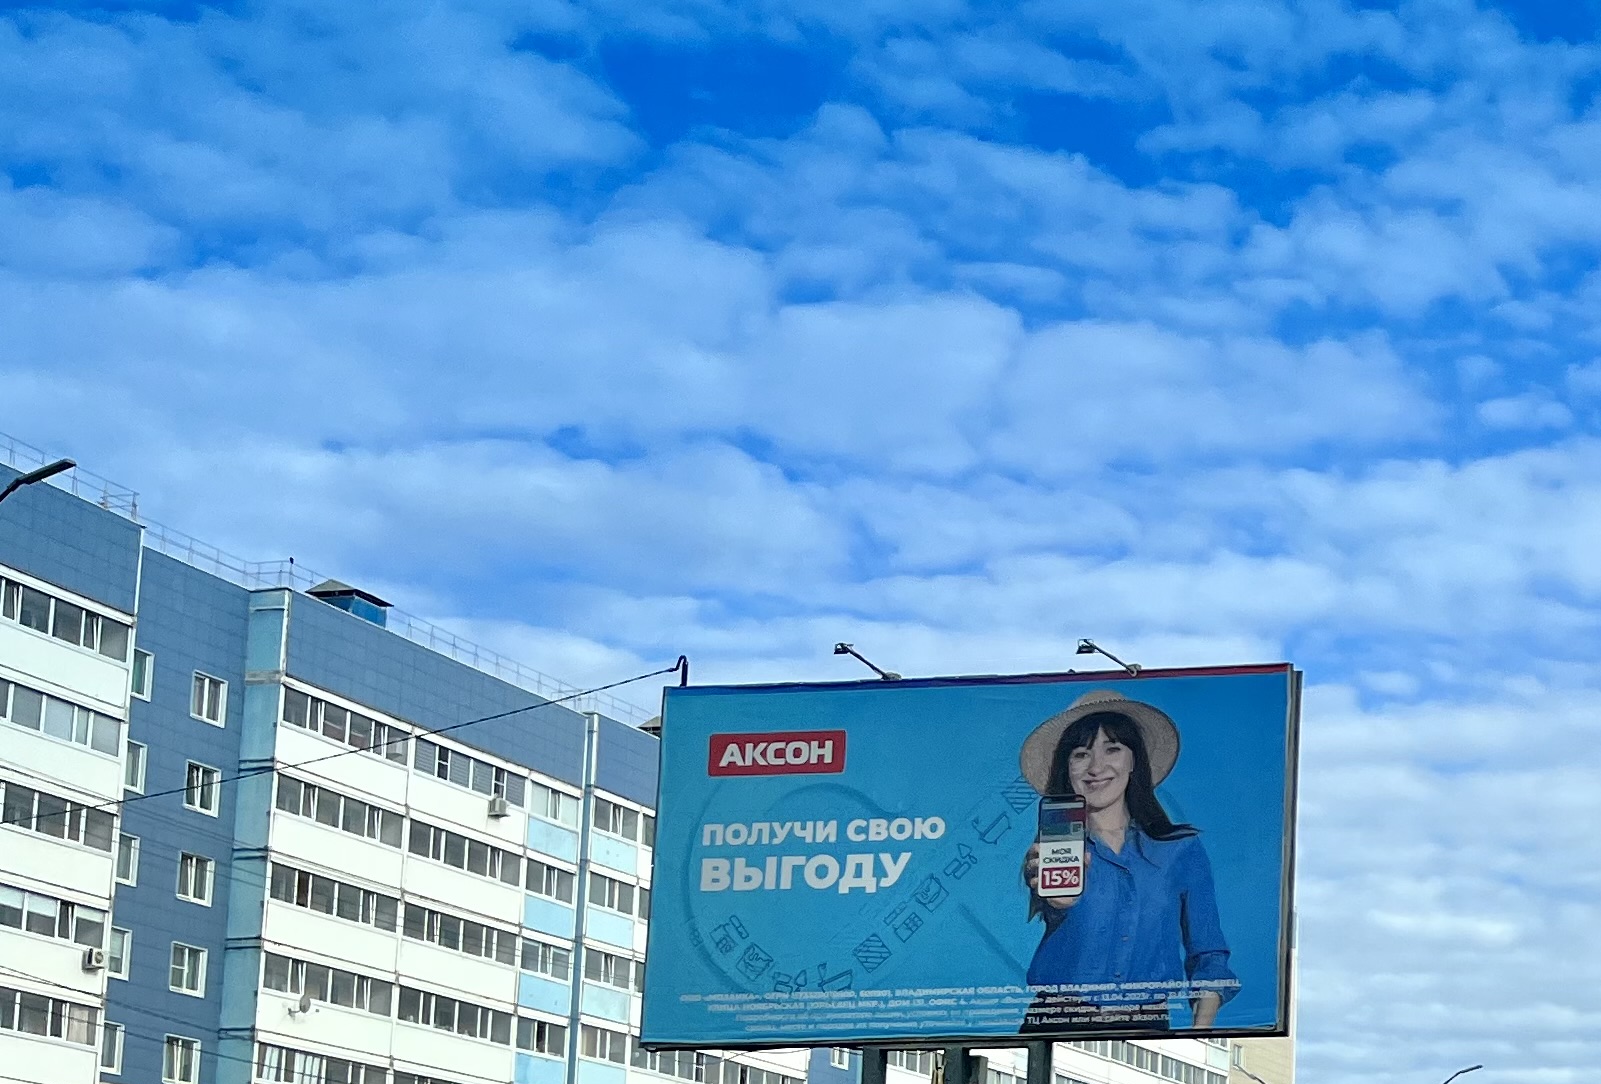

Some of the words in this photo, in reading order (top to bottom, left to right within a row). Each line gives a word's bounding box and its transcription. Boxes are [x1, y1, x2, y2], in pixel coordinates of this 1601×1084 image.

[718, 740, 834, 767] АКСОН
[702, 820, 837, 846] ПОЛУЧИ
[846, 816, 946, 842] СВОЮ
[1043, 855, 1080, 864] СКИДКА
[1051, 847, 1072, 855] МОЯ
[700, 852, 912, 894] ВЫГОДУ
[1043, 869, 1080, 886] 15%
